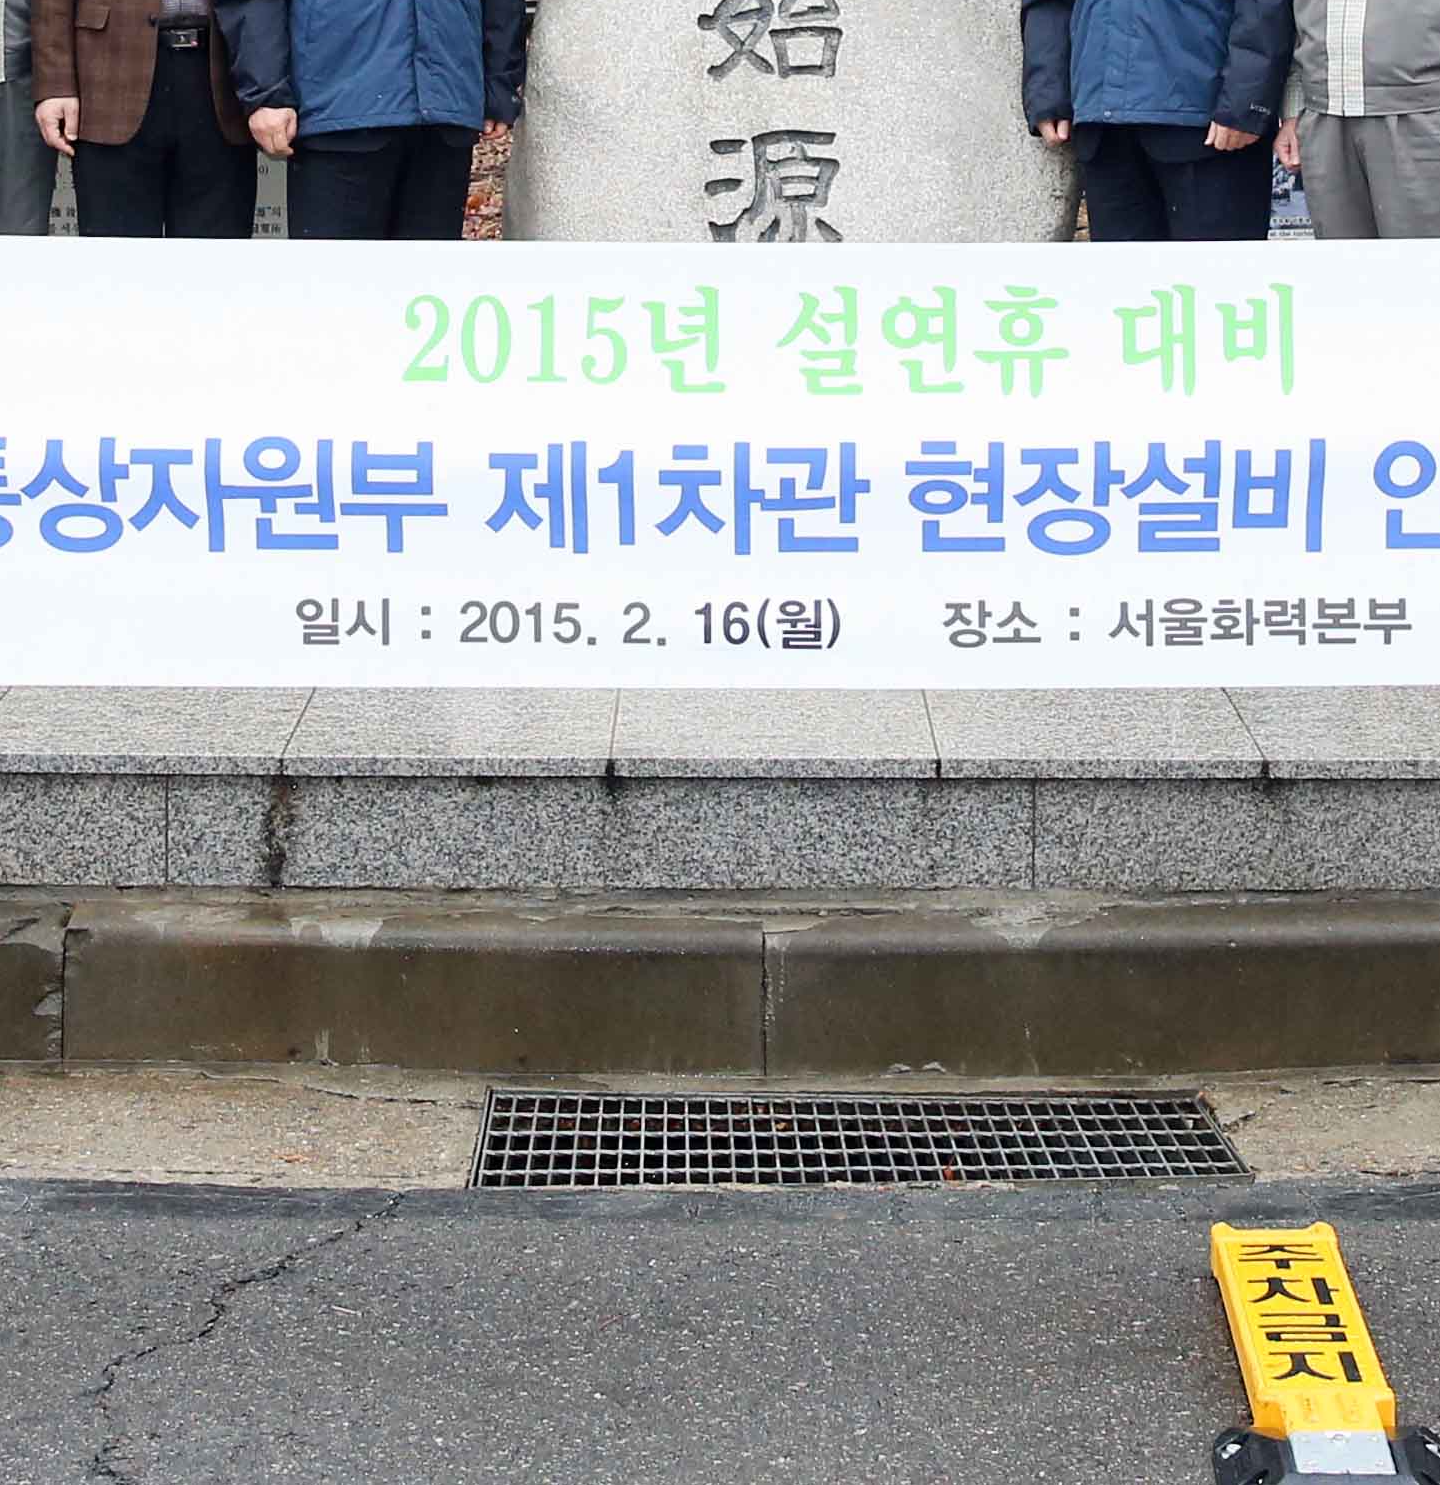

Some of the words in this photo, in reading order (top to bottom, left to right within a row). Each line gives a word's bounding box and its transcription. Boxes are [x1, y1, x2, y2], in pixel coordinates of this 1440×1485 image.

[403, 285, 727, 393] 2015년
[777, 284, 1070, 396] 설연휴
[1114, 282, 1295, 396] 대비
[487, 441, 870, 556] 제1차관
[905, 439, 1327, 556] 현장설비
[295, 597, 390, 645] 일시
[459, 600, 597, 646] 2015.
[622, 601, 667, 647] 2.
[694, 598, 841, 650] 16(월)
[942, 599, 1042, 649] 장소
[1108, 597, 1413, 647] 서울화력본부
[1238, 1244, 1363, 1382] 주차금지
